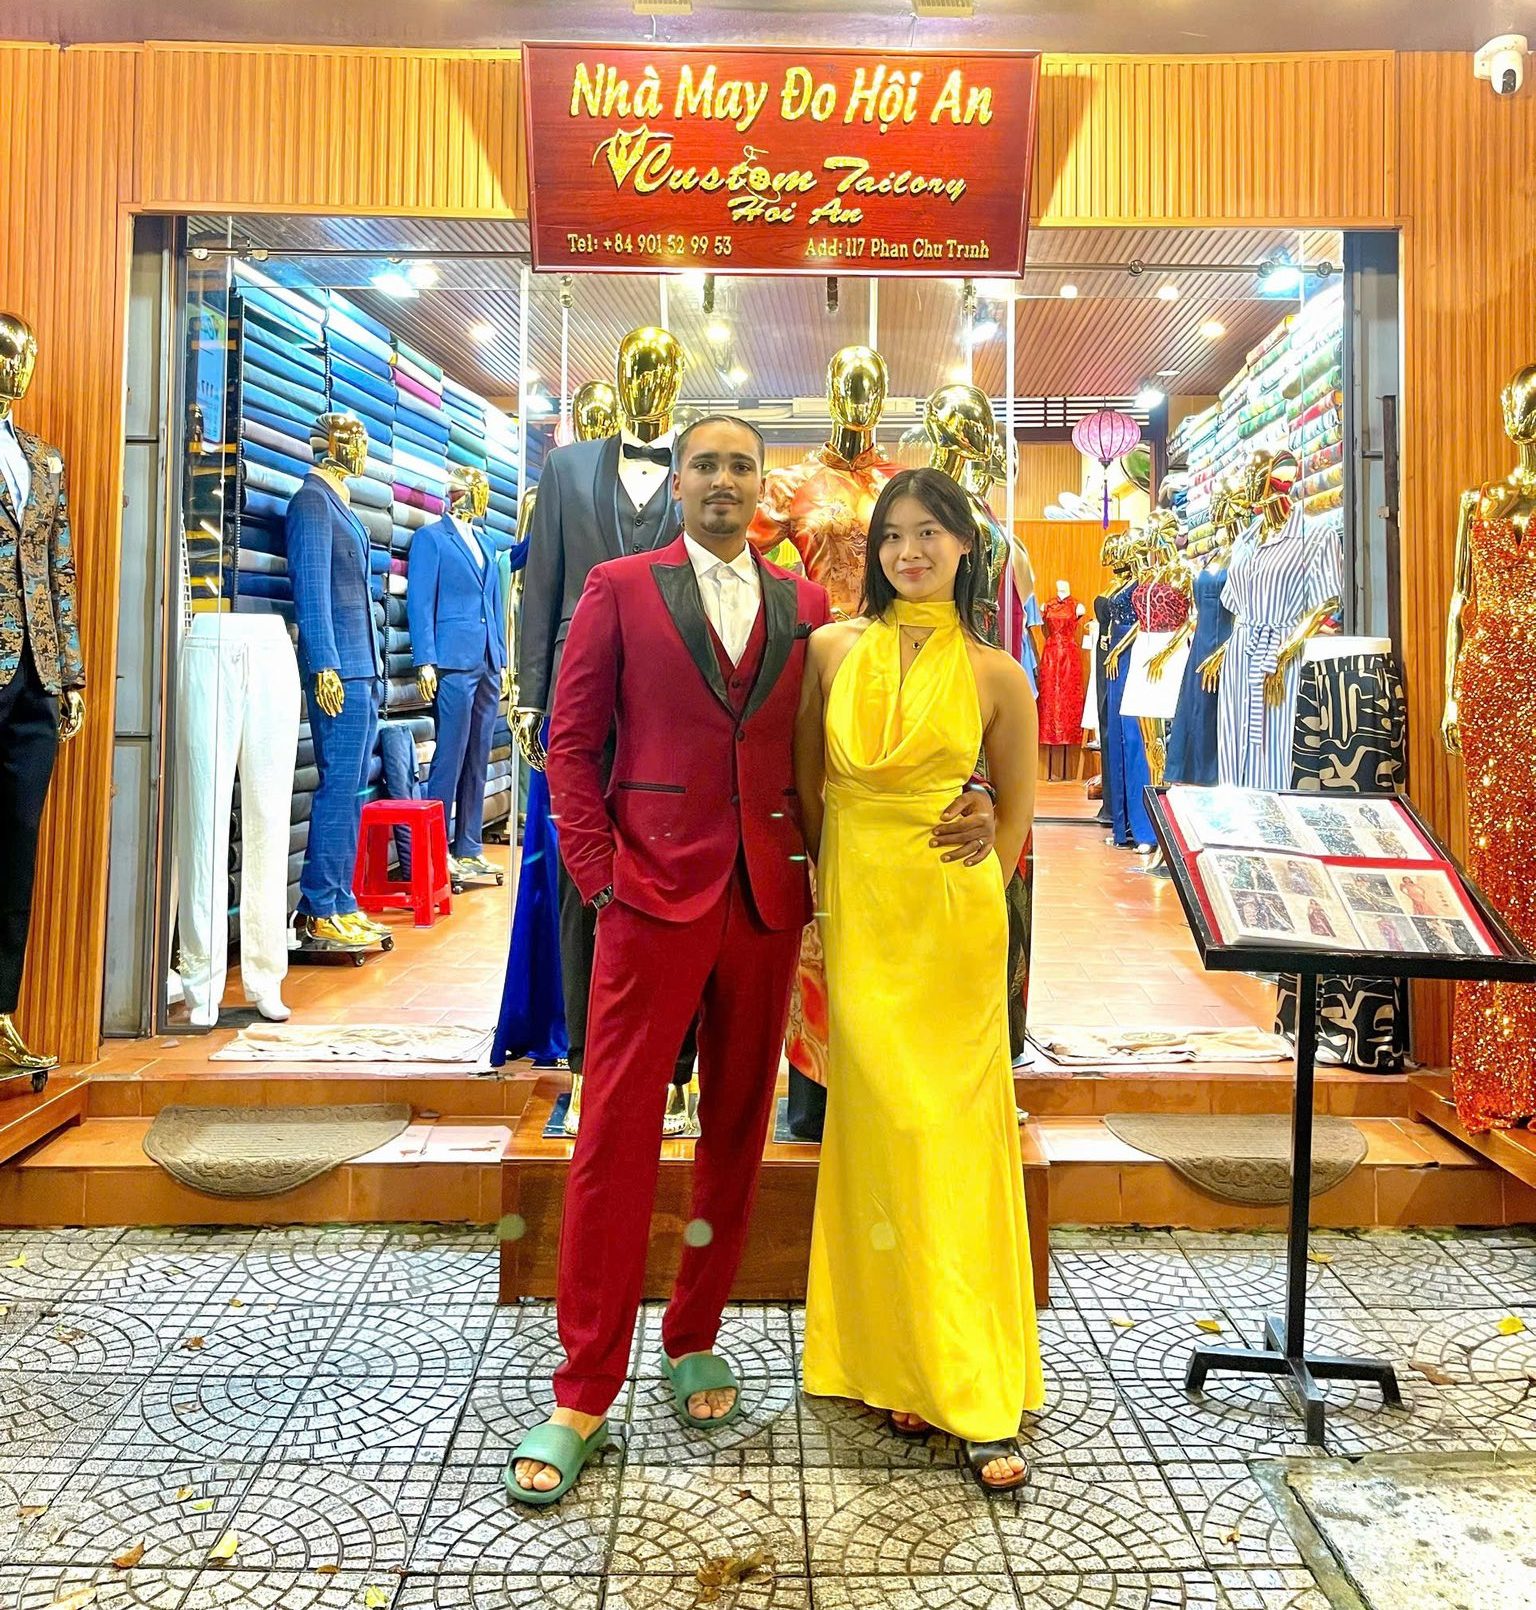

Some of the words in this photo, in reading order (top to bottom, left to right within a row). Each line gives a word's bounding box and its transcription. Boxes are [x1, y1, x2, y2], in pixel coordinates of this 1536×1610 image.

[570, 62, 663, 118] Nhà
[674, 64, 769, 133] May
[780, 66, 837, 122] Đo
[843, 64, 923, 134] Hội
[930, 69, 994, 125] An
[634, 142, 817, 194] Custom
[727, 196, 797, 222] Hoi
[808, 198, 864, 225] An
[567, 233, 598, 253] Tel:
[603, 233, 633, 253] +84
[637, 234, 662, 254] 901
[667, 234, 685, 254] 52
[690, 235, 709, 255] 99
[714, 235, 732, 256] 53
[870, 238, 909, 258] Phan
[912, 238, 943, 258] Chu
